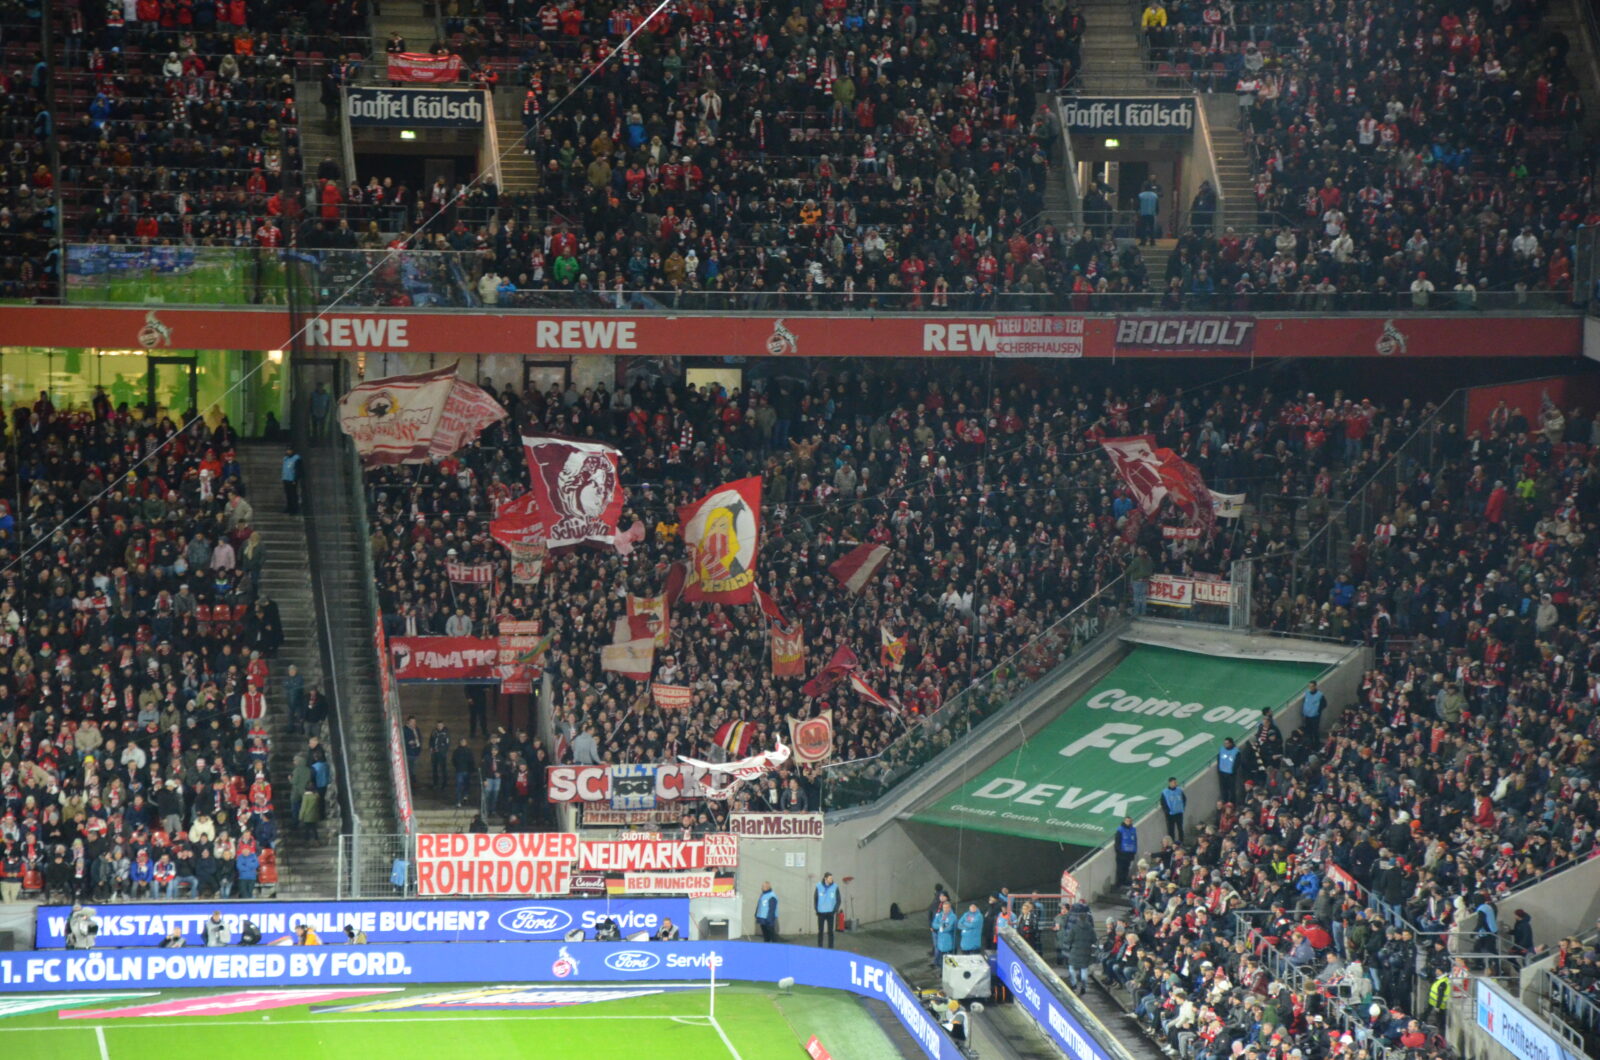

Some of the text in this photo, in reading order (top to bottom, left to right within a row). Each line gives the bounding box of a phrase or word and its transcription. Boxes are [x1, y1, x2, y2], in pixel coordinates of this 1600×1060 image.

[349, 91, 482, 122] Gaffel Kölsch
[1125, 102, 1193, 130] Kölsch
[305, 318, 409, 348] REWE
[536, 320, 637, 349] REWE
[923, 323, 997, 351] REW
[1116, 319, 1254, 347] BOCHOLT
[1148, 580, 1186, 600] EBELS
[1087, 688, 1204, 719] Come
[1058, 722, 1216, 769] FC!
[971, 777, 1150, 818] DEVK
[731, 816, 823, 836] alarMstufe
[417, 832, 577, 858] RED POWER
[579, 841, 703, 869] NEUMARKT
[417, 860, 570, 894] ROHRDORF
[627, 876, 650, 889] RED
[380, 910, 489, 932] BUCHEN?
[512, 910, 558, 930] Ford
[1, 952, 412, 983] 1. FC KÖLN POWERED BY FORD.
[666, 953, 723, 968] Service
[863, 965, 884, 992] FC
